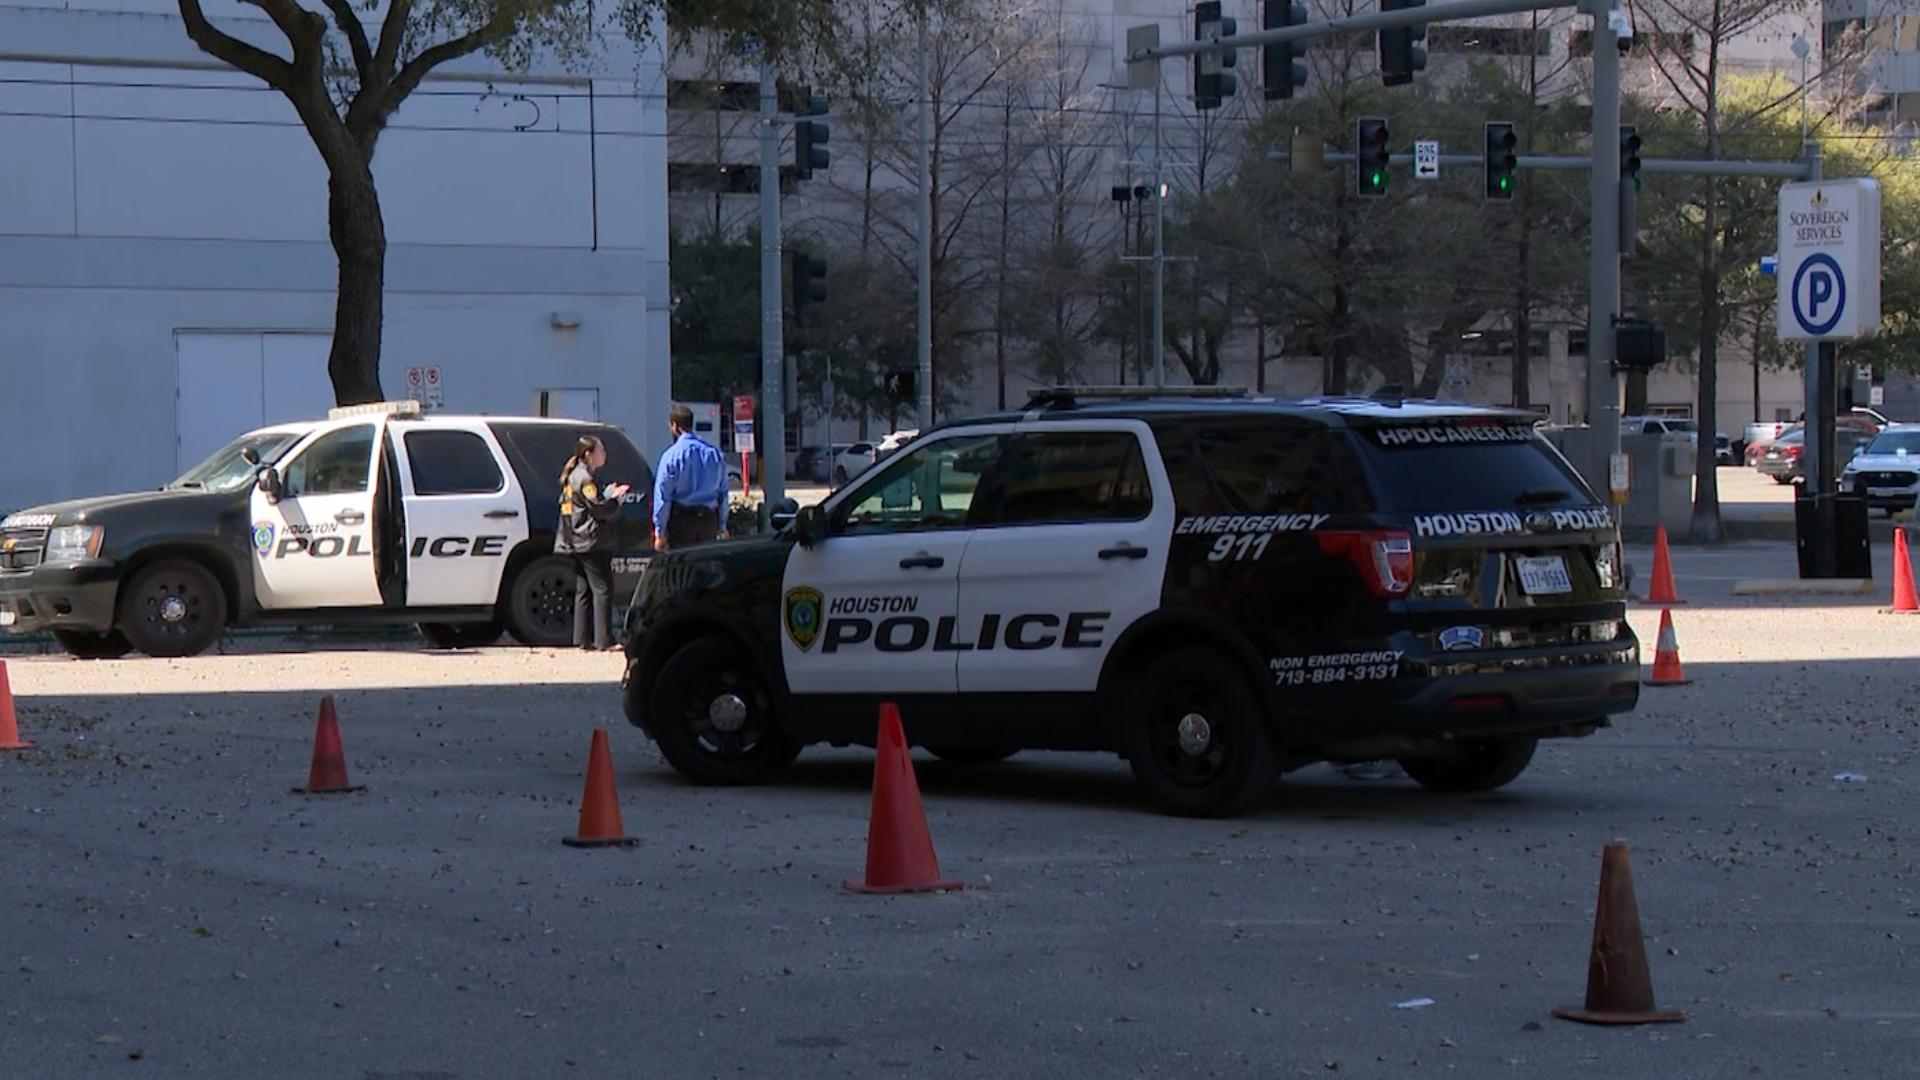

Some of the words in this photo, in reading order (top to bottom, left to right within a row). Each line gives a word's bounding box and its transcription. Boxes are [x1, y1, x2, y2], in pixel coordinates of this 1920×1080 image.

[1418, 144, 1435, 153] ONE
[1418, 155, 1435, 163] WAY
[1790, 210, 1849, 226] SOVEREIGN
[1796, 226, 1842, 241] SERVICES
[1810, 271, 1832, 317] P
[281, 522, 338, 536] HOUSTON
[1175, 513, 1330, 534] EMERGENCY
[1414, 513, 1522, 536] HOUSTON
[1551, 507, 1614, 530] POLICE
[1207, 532, 1273, 562] 911
[830, 597, 918, 613] HOUSTON
[822, 612, 1111, 653] POLICE
[1270, 657, 1304, 670] NON
[1307, 650, 1404, 668] EMERGENCY
[1276, 663, 1399, 685] 713-884-3131
